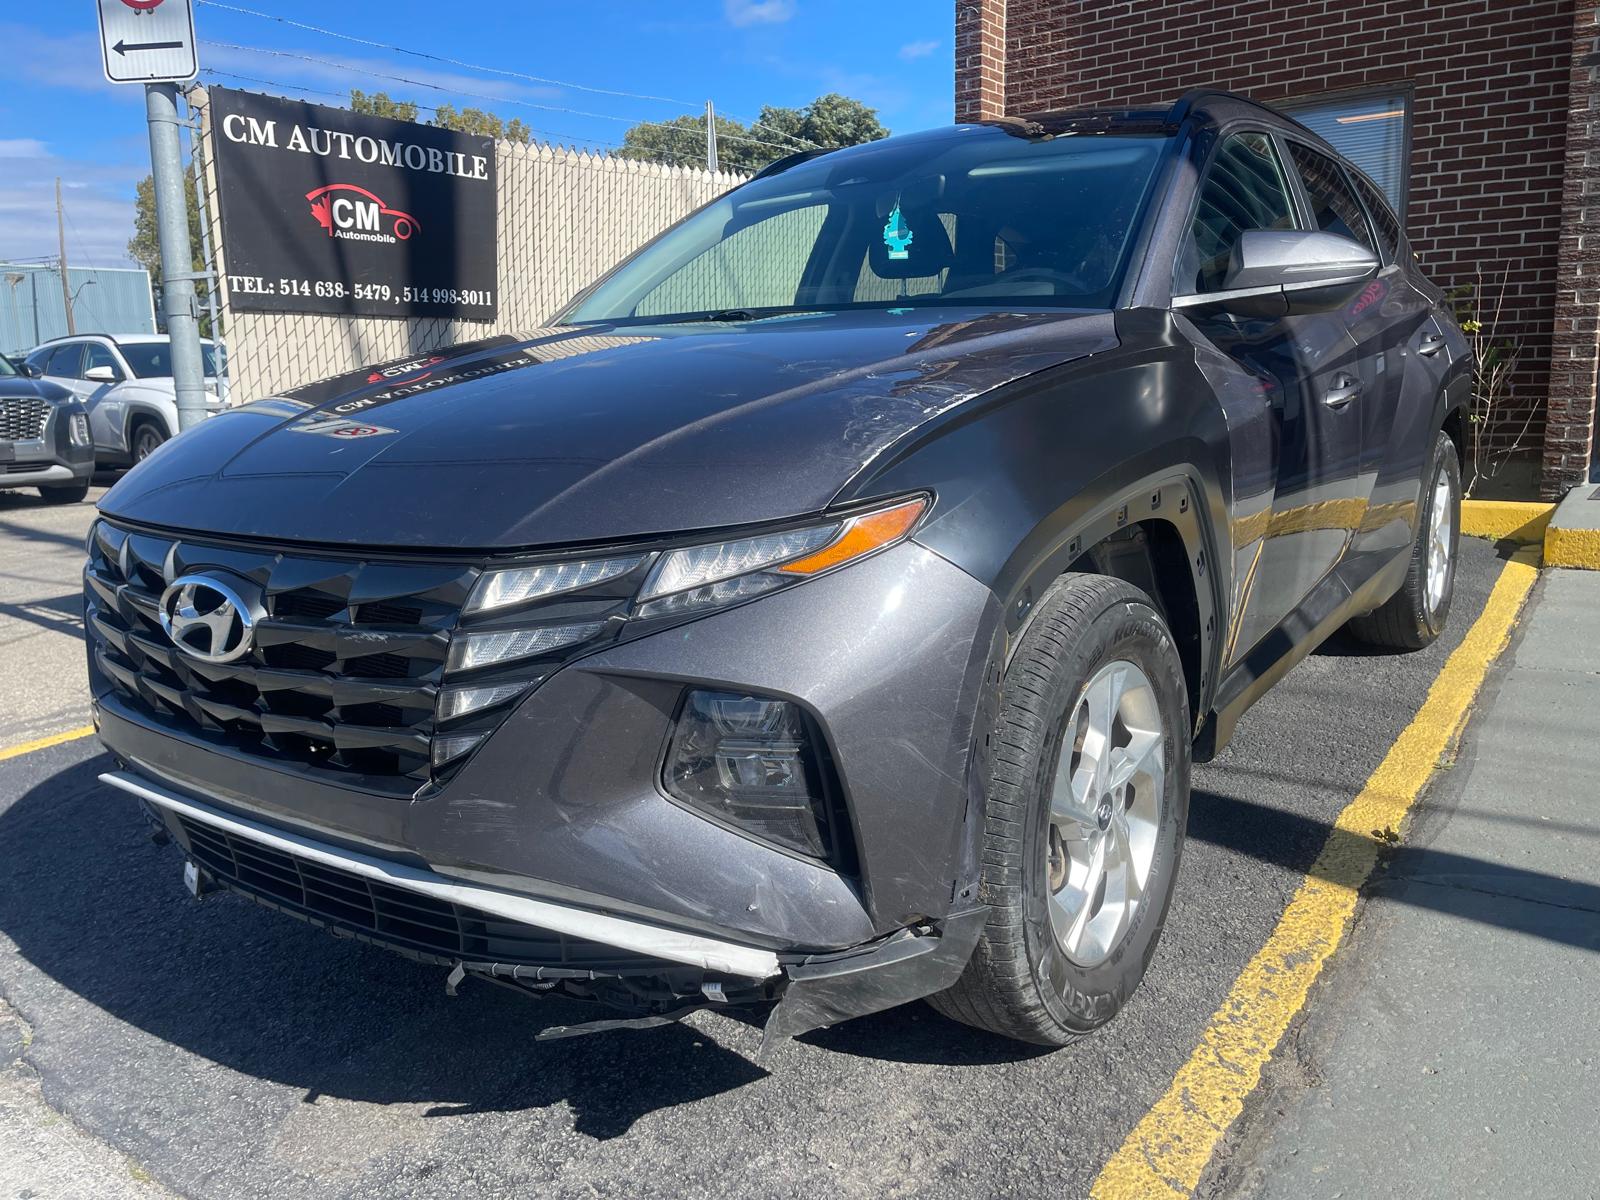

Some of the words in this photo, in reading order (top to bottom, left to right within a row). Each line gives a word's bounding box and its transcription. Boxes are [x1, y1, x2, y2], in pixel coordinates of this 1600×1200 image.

[223, 114, 278, 148] CM
[287, 125, 489, 181] AUTOMOBILE
[332, 198, 380, 231] CM
[334, 229, 396, 243] Automobile
[228, 276, 275, 294] TEL:
[280, 279, 311, 296] 514
[354, 283, 391, 301] 5479
[403, 286, 428, 302] 514
[432, 288, 492, 306] 998-3011
